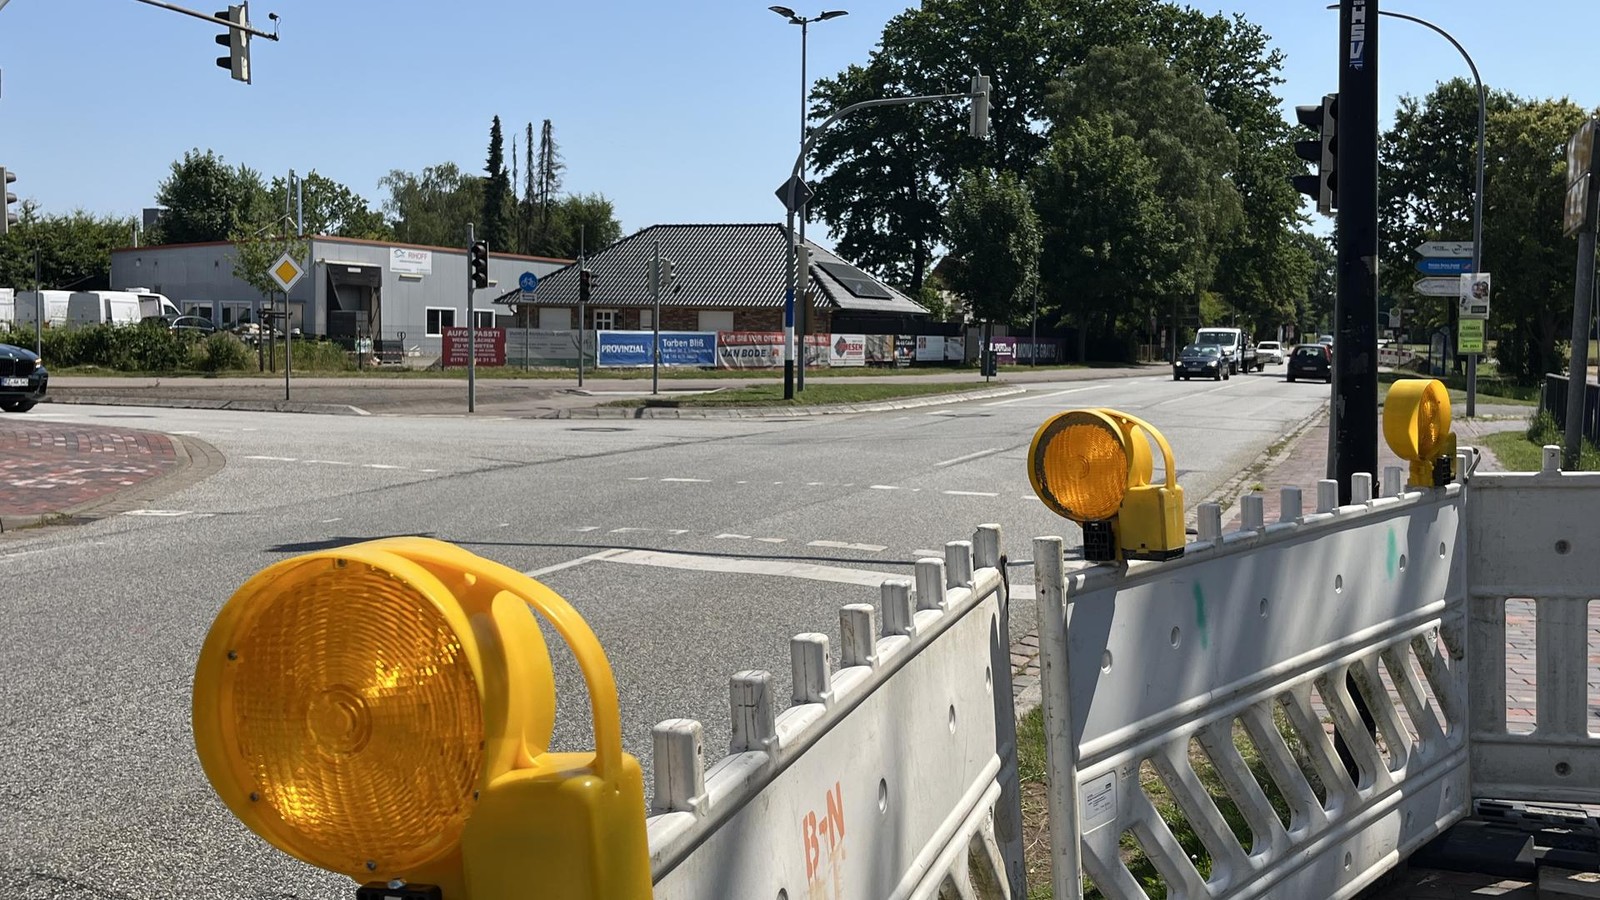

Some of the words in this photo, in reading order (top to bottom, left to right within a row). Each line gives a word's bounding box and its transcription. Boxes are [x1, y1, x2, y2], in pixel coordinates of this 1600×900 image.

[1350, 6, 1366, 59] HSV
[447, 330, 500, 338] AUFGPASST!
[662, 338, 688, 347] Torben
[601, 344, 645, 353] PROVINZIAL
[721, 349, 740, 358] JAN
[741, 349, 768, 358] BODE
